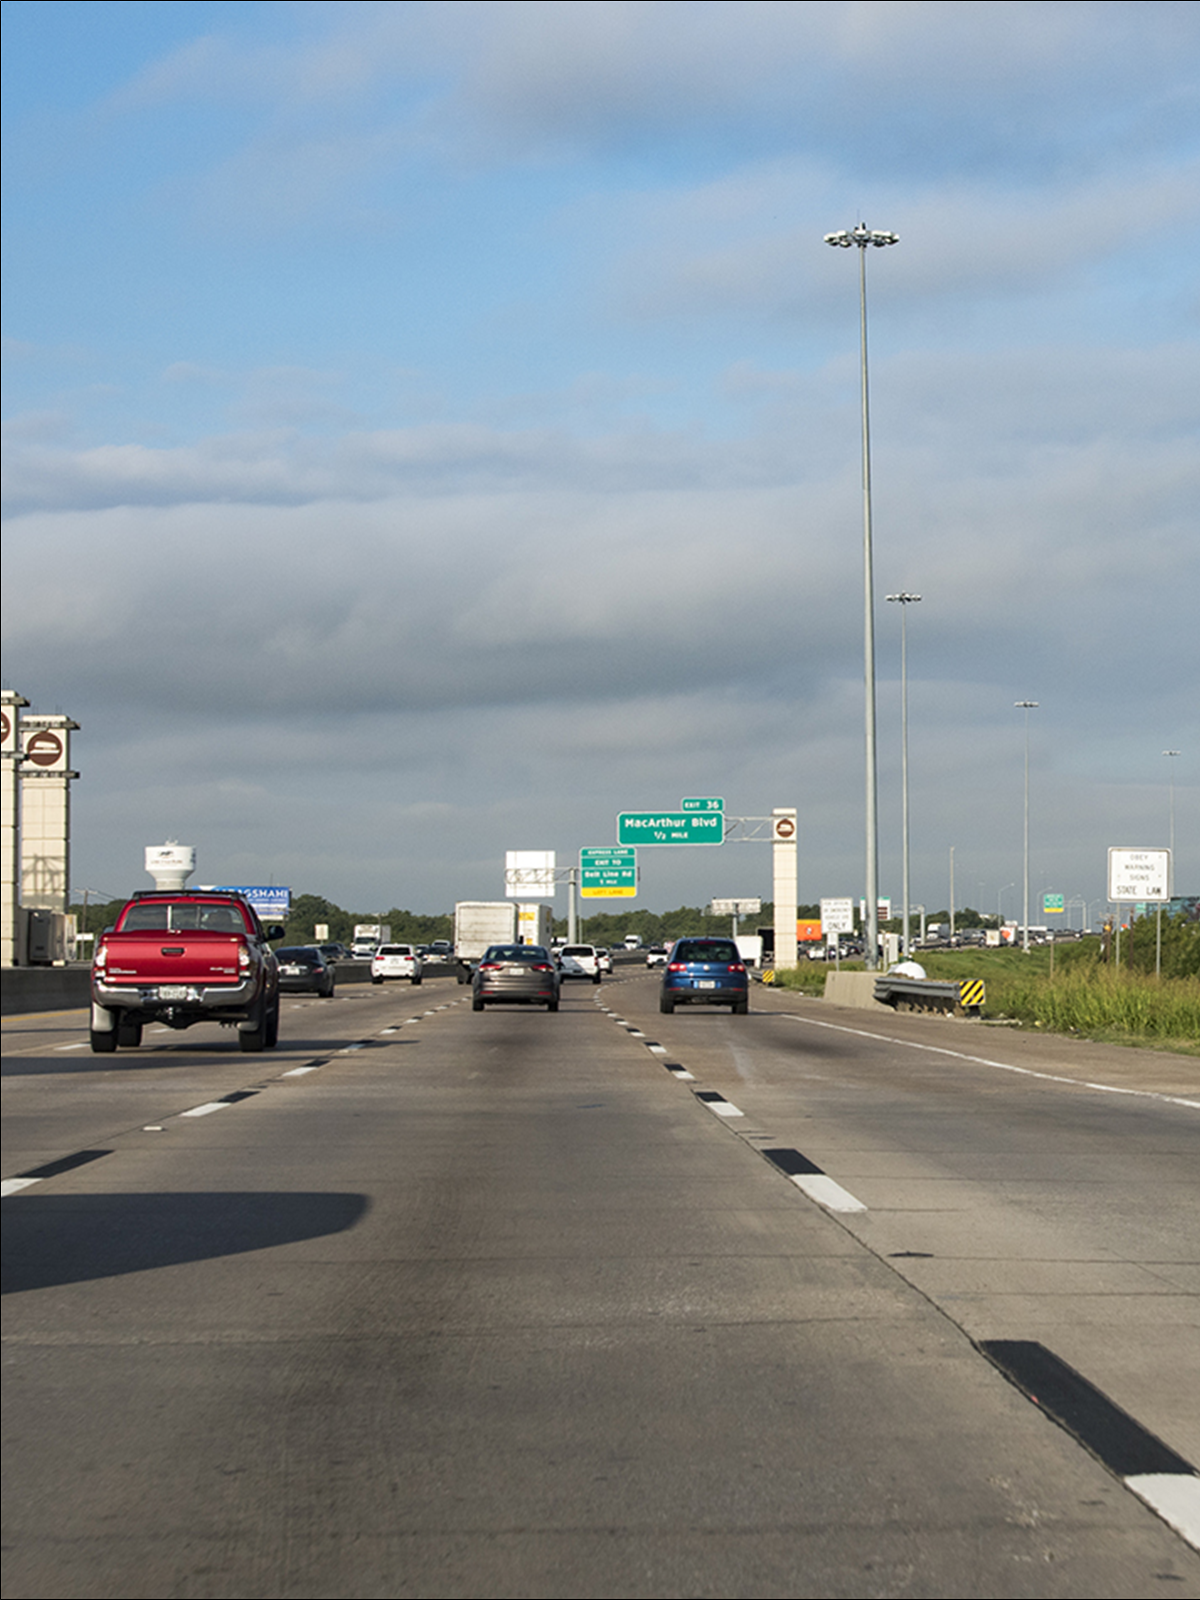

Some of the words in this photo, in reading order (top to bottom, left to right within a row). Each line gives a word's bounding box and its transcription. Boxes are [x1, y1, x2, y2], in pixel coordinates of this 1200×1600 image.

[684, 801, 700, 809] EXIT
[706, 800, 719, 810] 36
[625, 817, 686, 828] MacArthur
[691, 817, 717, 827] Blvd
[1116, 885, 1137, 896] STATE
[1146, 886, 1162, 896] LAW
[827, 922, 847, 931] ONLY
